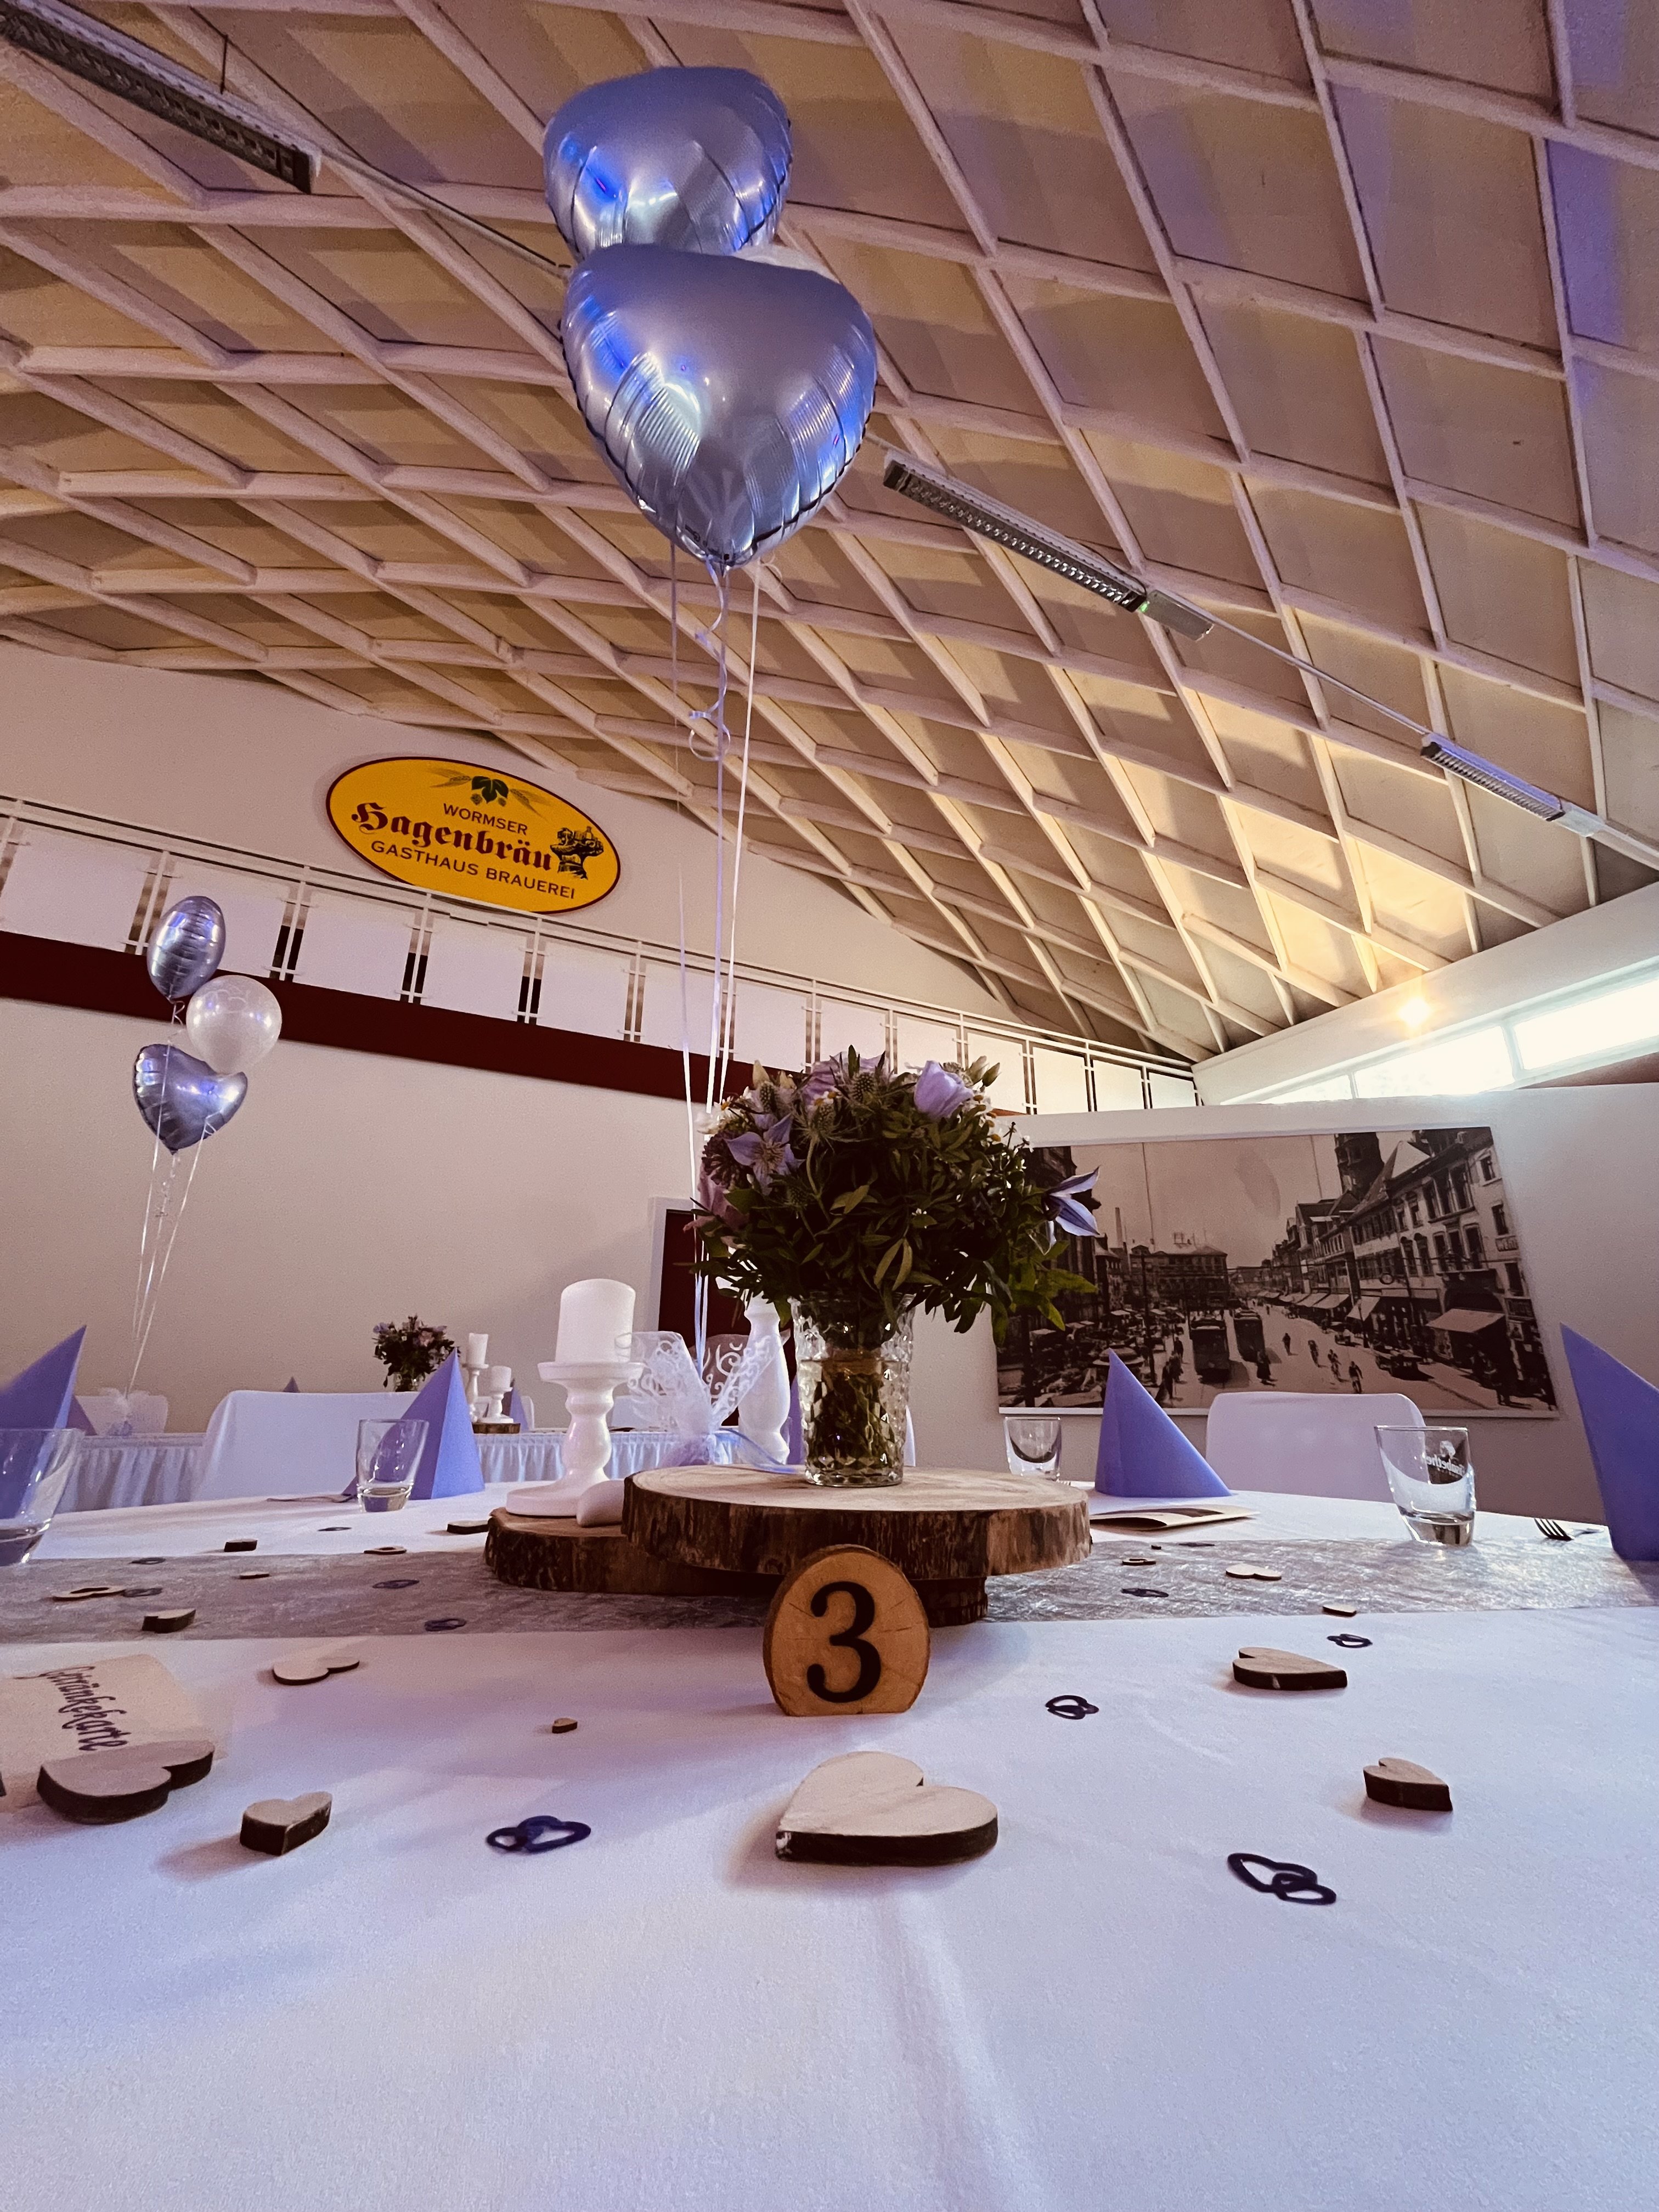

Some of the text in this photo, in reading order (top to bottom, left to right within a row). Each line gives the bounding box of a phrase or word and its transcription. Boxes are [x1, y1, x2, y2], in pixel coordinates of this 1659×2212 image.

[351, 802, 552, 871] Hagenbräu
[443, 803, 528, 836] WORMSER
[371, 840, 575, 899] GASTHAUS BRAUEREI
[806, 1581, 881, 1703] 3
